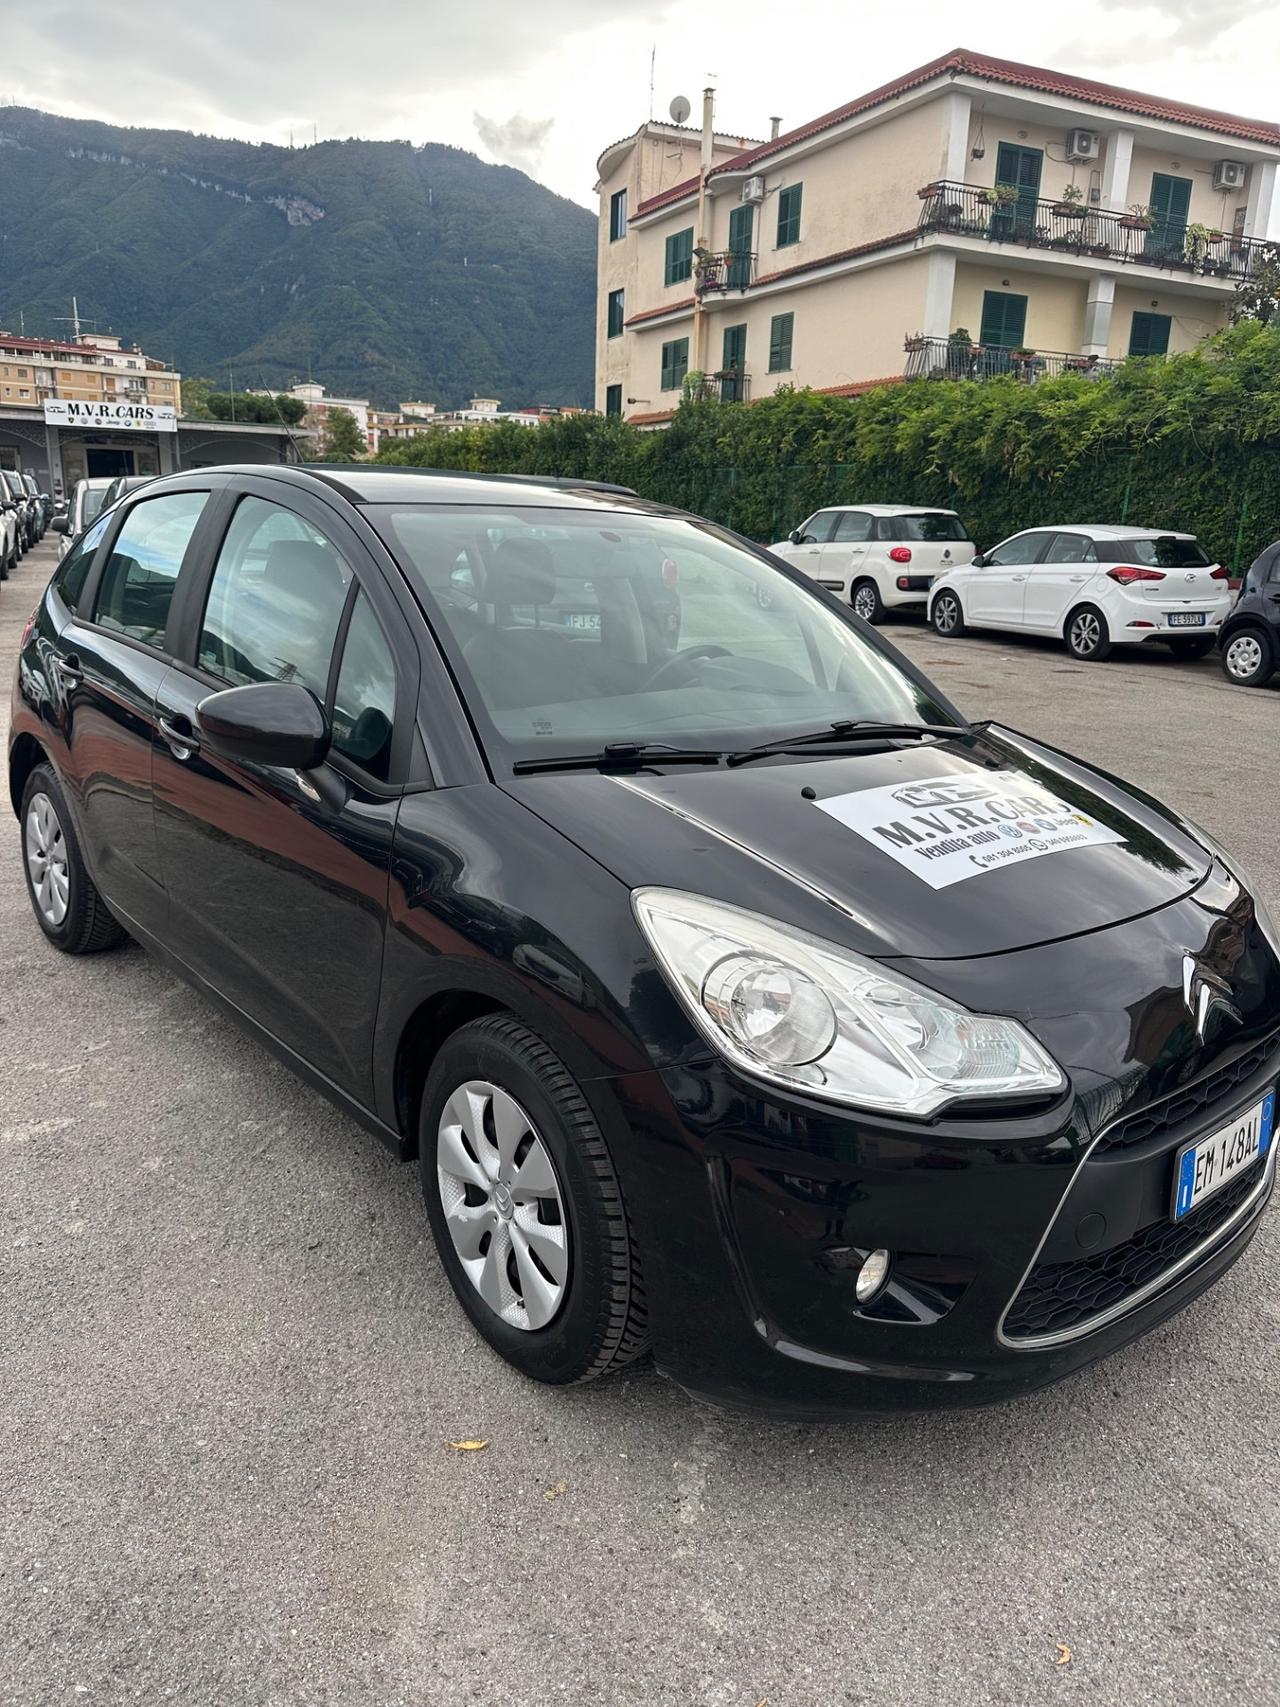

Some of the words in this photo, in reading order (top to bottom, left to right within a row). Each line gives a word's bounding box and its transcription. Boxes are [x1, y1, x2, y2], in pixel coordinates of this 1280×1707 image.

[914, 838, 974, 860] Vendita
[967, 830, 1001, 846] auto
[1194, 1145, 1216, 1195] EM
[1220, 1117, 1258, 1177] 148AL
